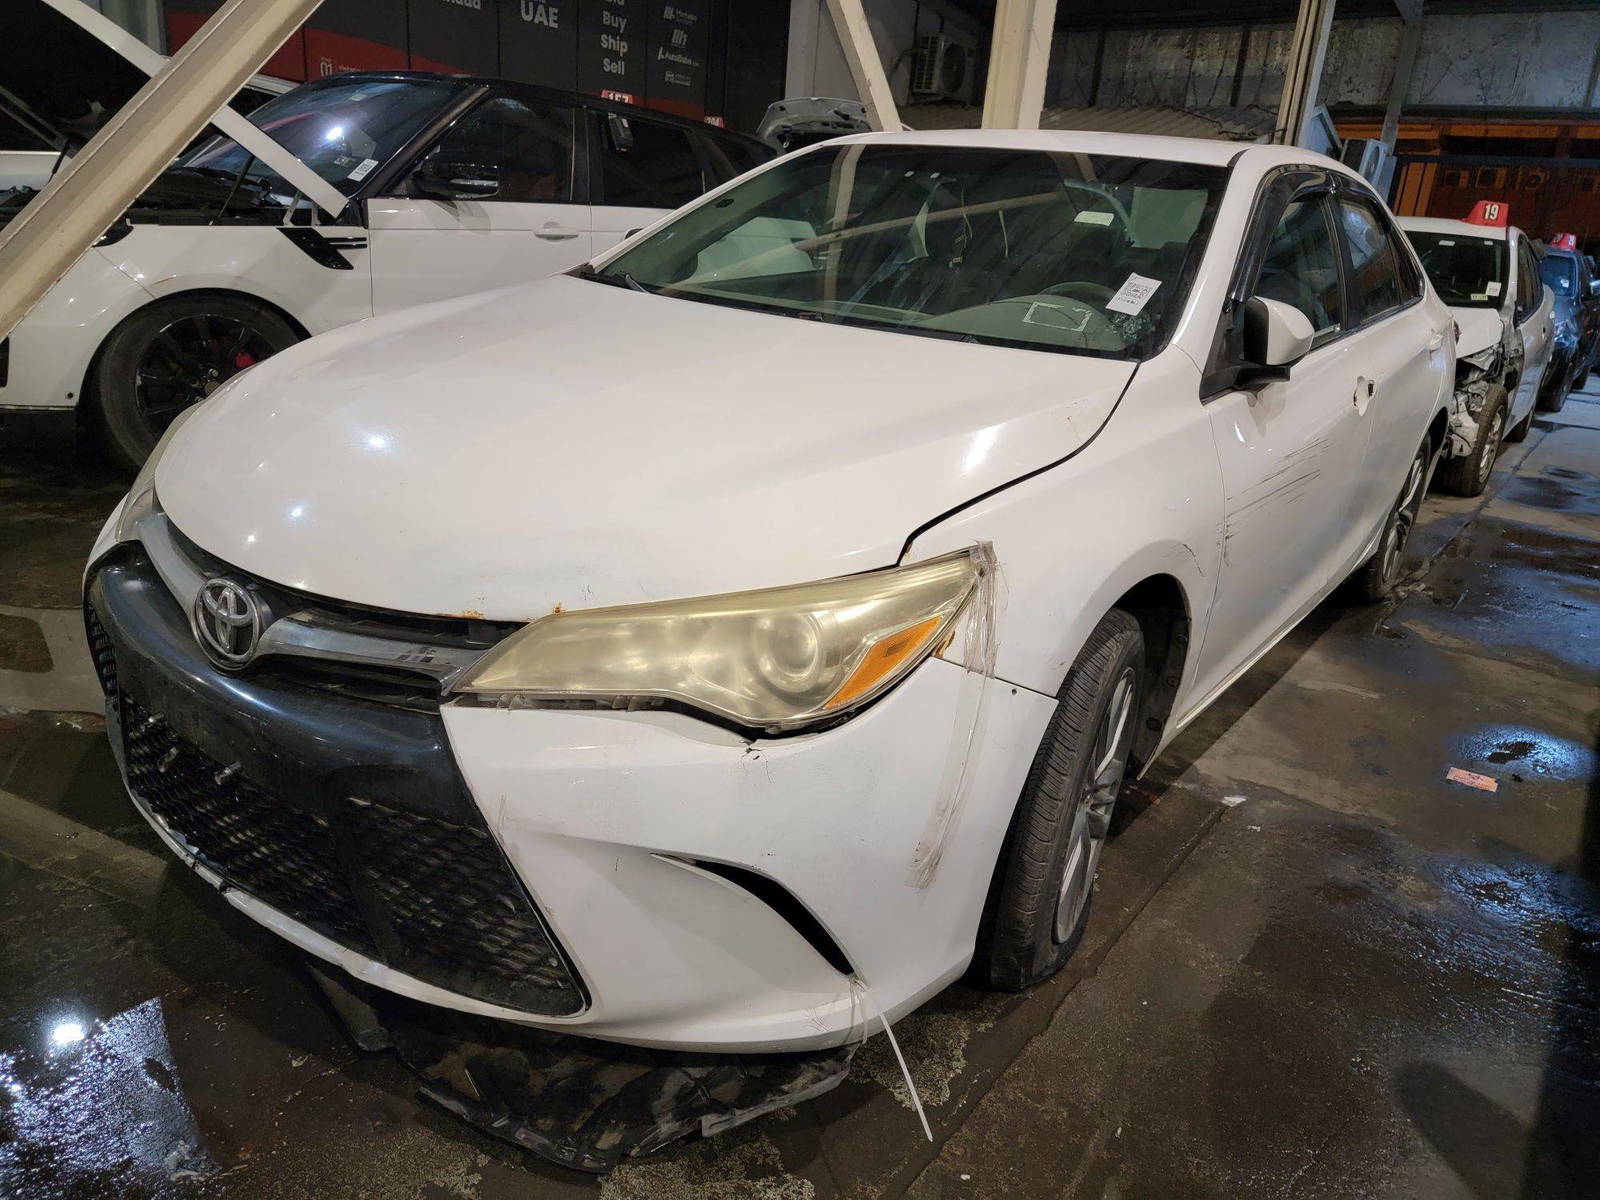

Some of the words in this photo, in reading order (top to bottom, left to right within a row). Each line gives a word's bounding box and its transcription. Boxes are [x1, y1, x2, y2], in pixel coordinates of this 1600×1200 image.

[520, 0, 559, 28] UAE
[602, 10, 627, 33] Buy
[600, 33, 629, 57] Ship
[602, 57, 625, 75] Sell
[1484, 204, 1499, 220] 19
